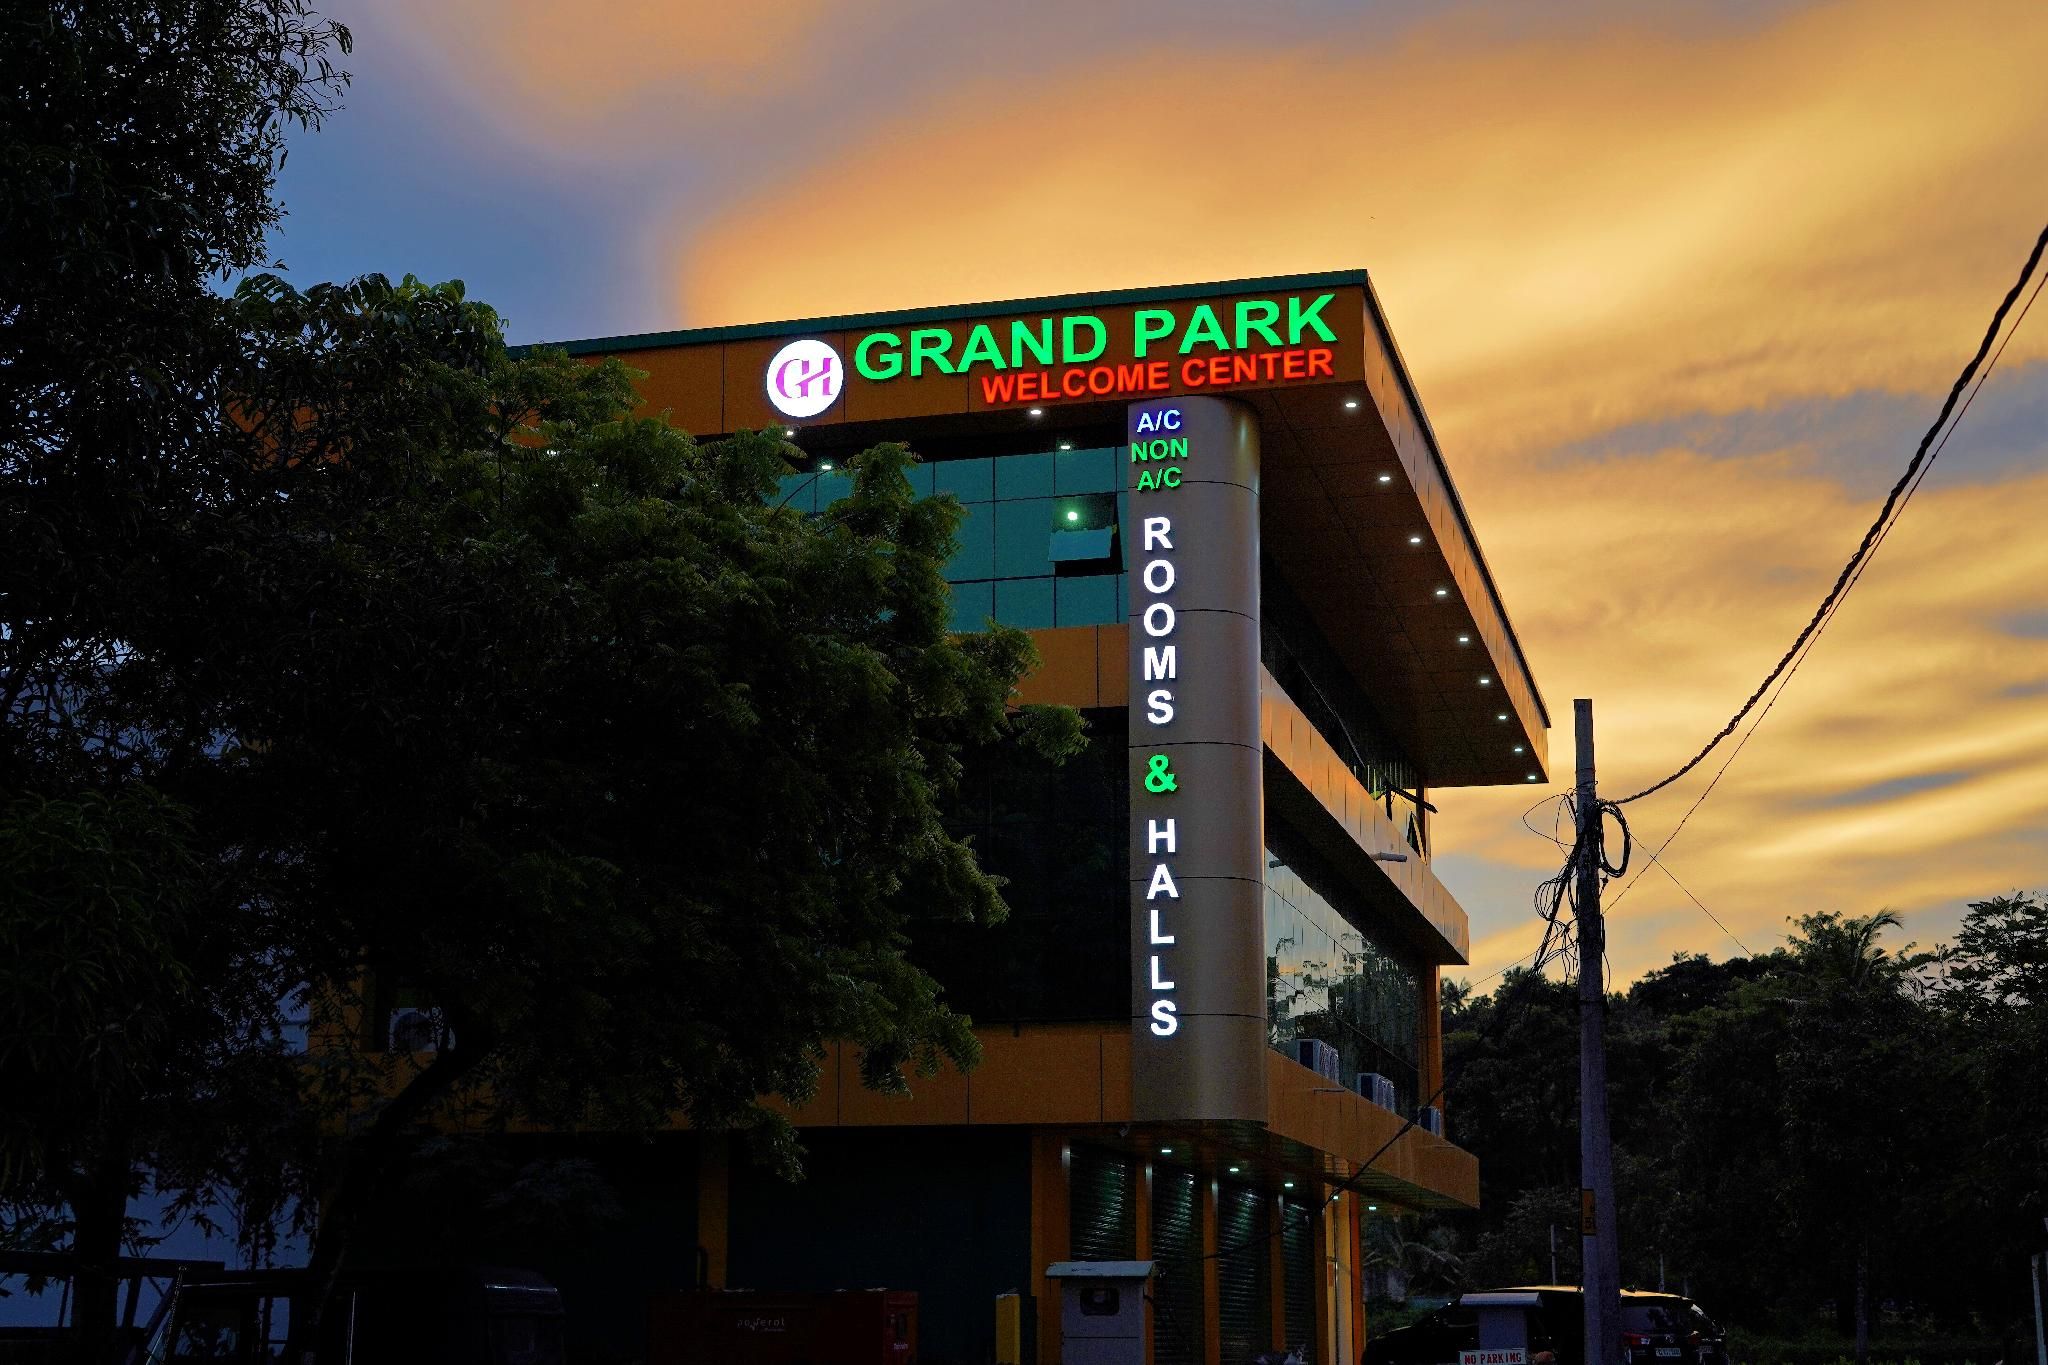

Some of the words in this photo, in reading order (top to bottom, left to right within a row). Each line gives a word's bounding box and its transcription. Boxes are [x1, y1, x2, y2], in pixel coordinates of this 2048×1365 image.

[854, 315, 1107, 381] GRAND
[1134, 293, 1339, 358] PARK
[981, 361, 1171, 404] WELCOME
[1181, 348, 1334, 388] CENTER
[1136, 408, 1182, 434] A/C
[1130, 437, 1190, 463] NON
[1137, 465, 1183, 491] A/C
[1143, 515, 1176, 726] ROOMS
[1144, 754, 1178, 793] &
[1146, 818, 1179, 1036] HALLS
[1464, 1354, 1477, 1365] NO
[1480, 1352, 1522, 1364] PARKING
